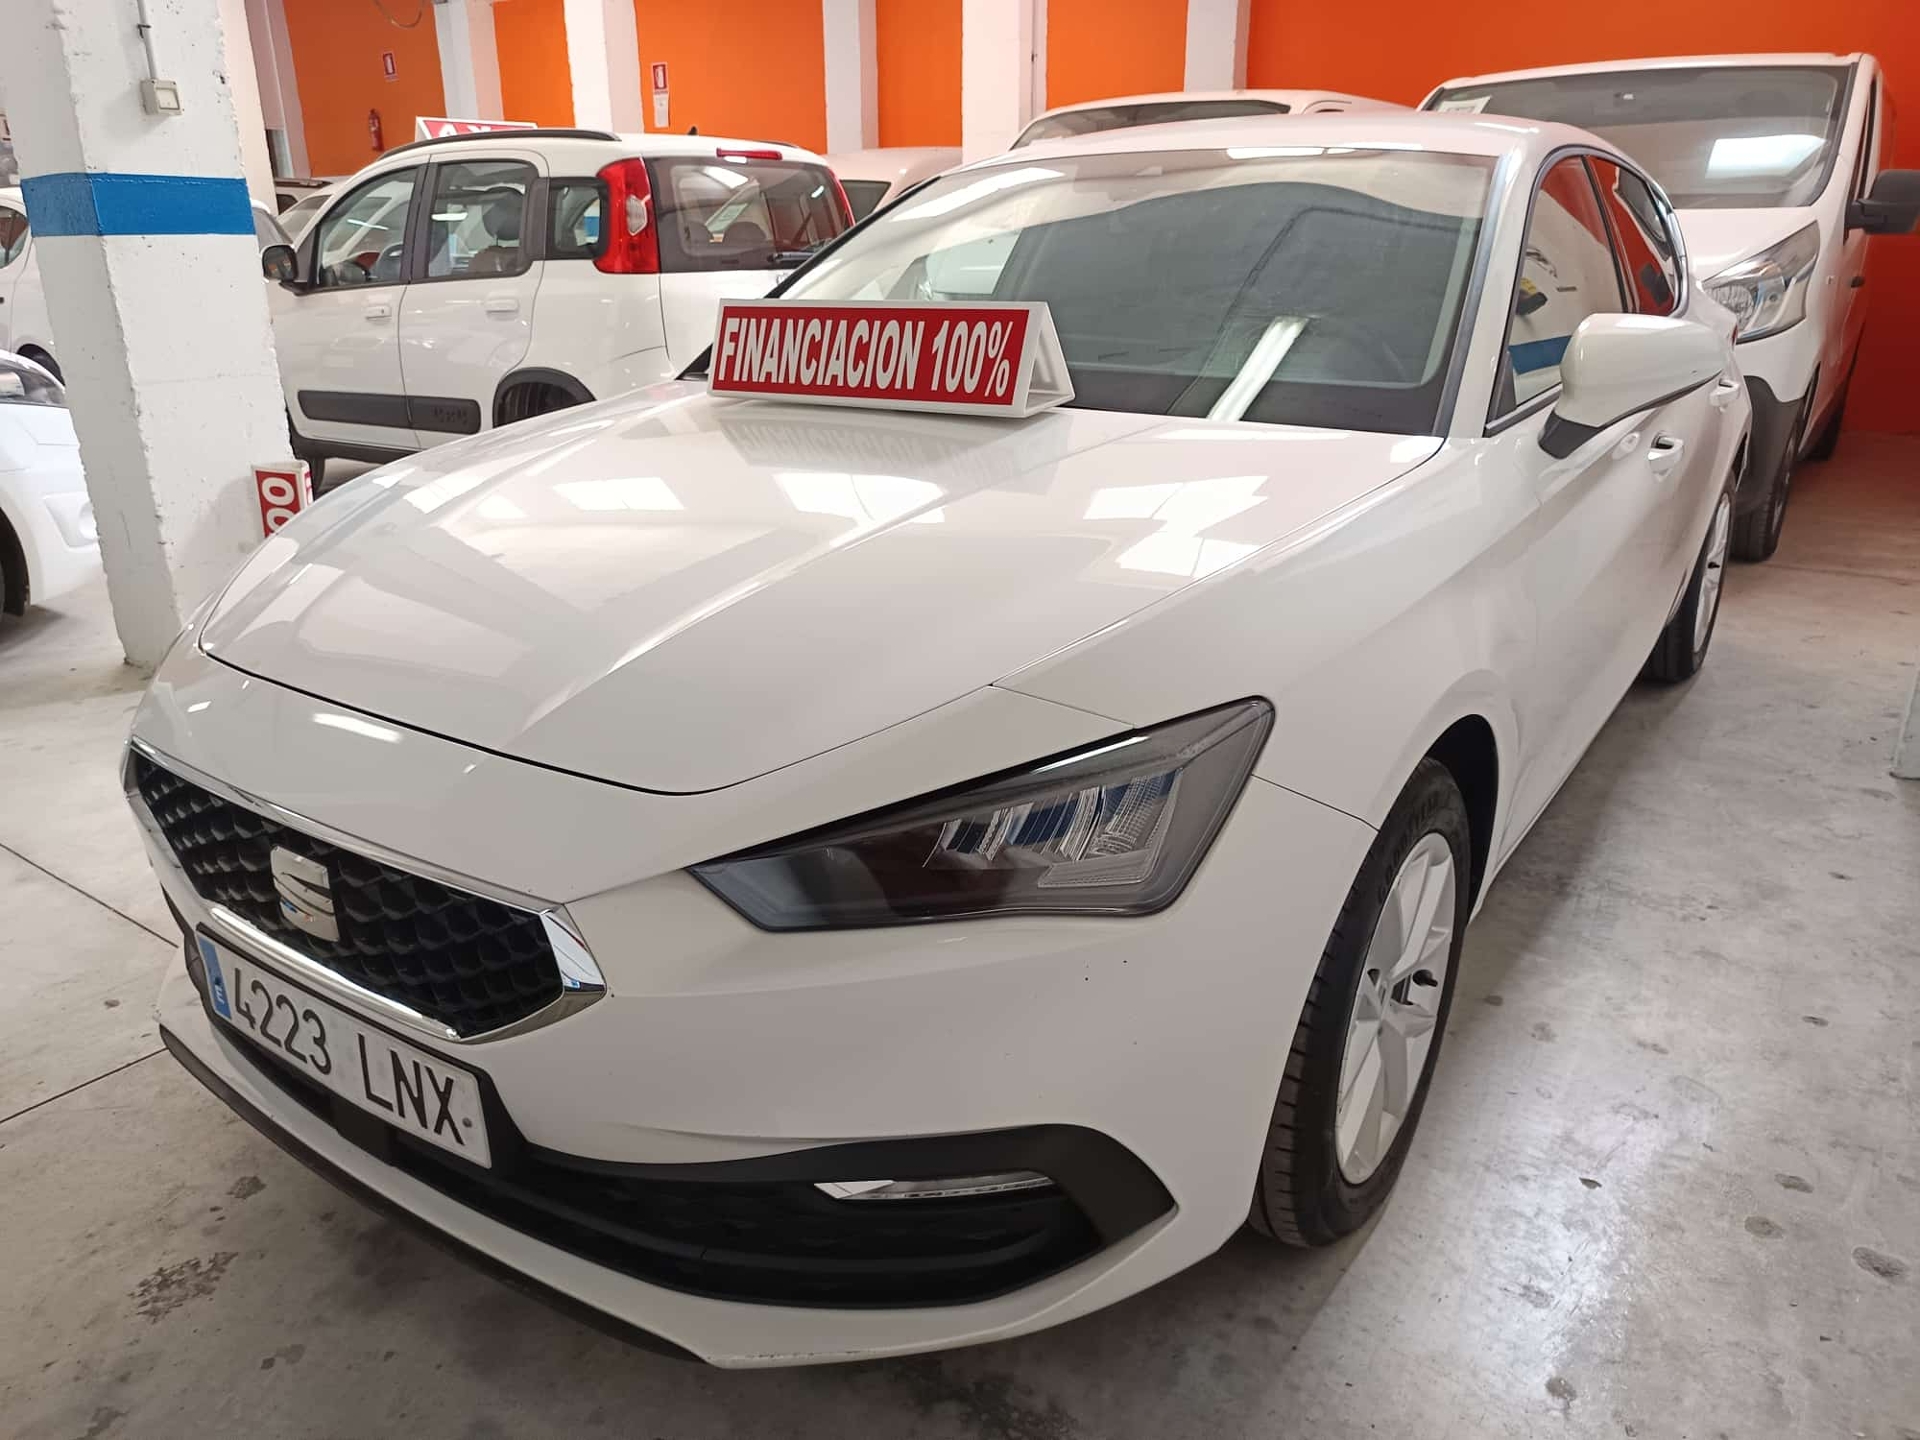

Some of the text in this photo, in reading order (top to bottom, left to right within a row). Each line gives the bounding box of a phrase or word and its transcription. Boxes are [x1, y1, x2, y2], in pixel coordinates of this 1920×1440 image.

[718, 317, 1014, 397] FINANCIACION 100%
[234, 968, 466, 1146] 4223 LNX
